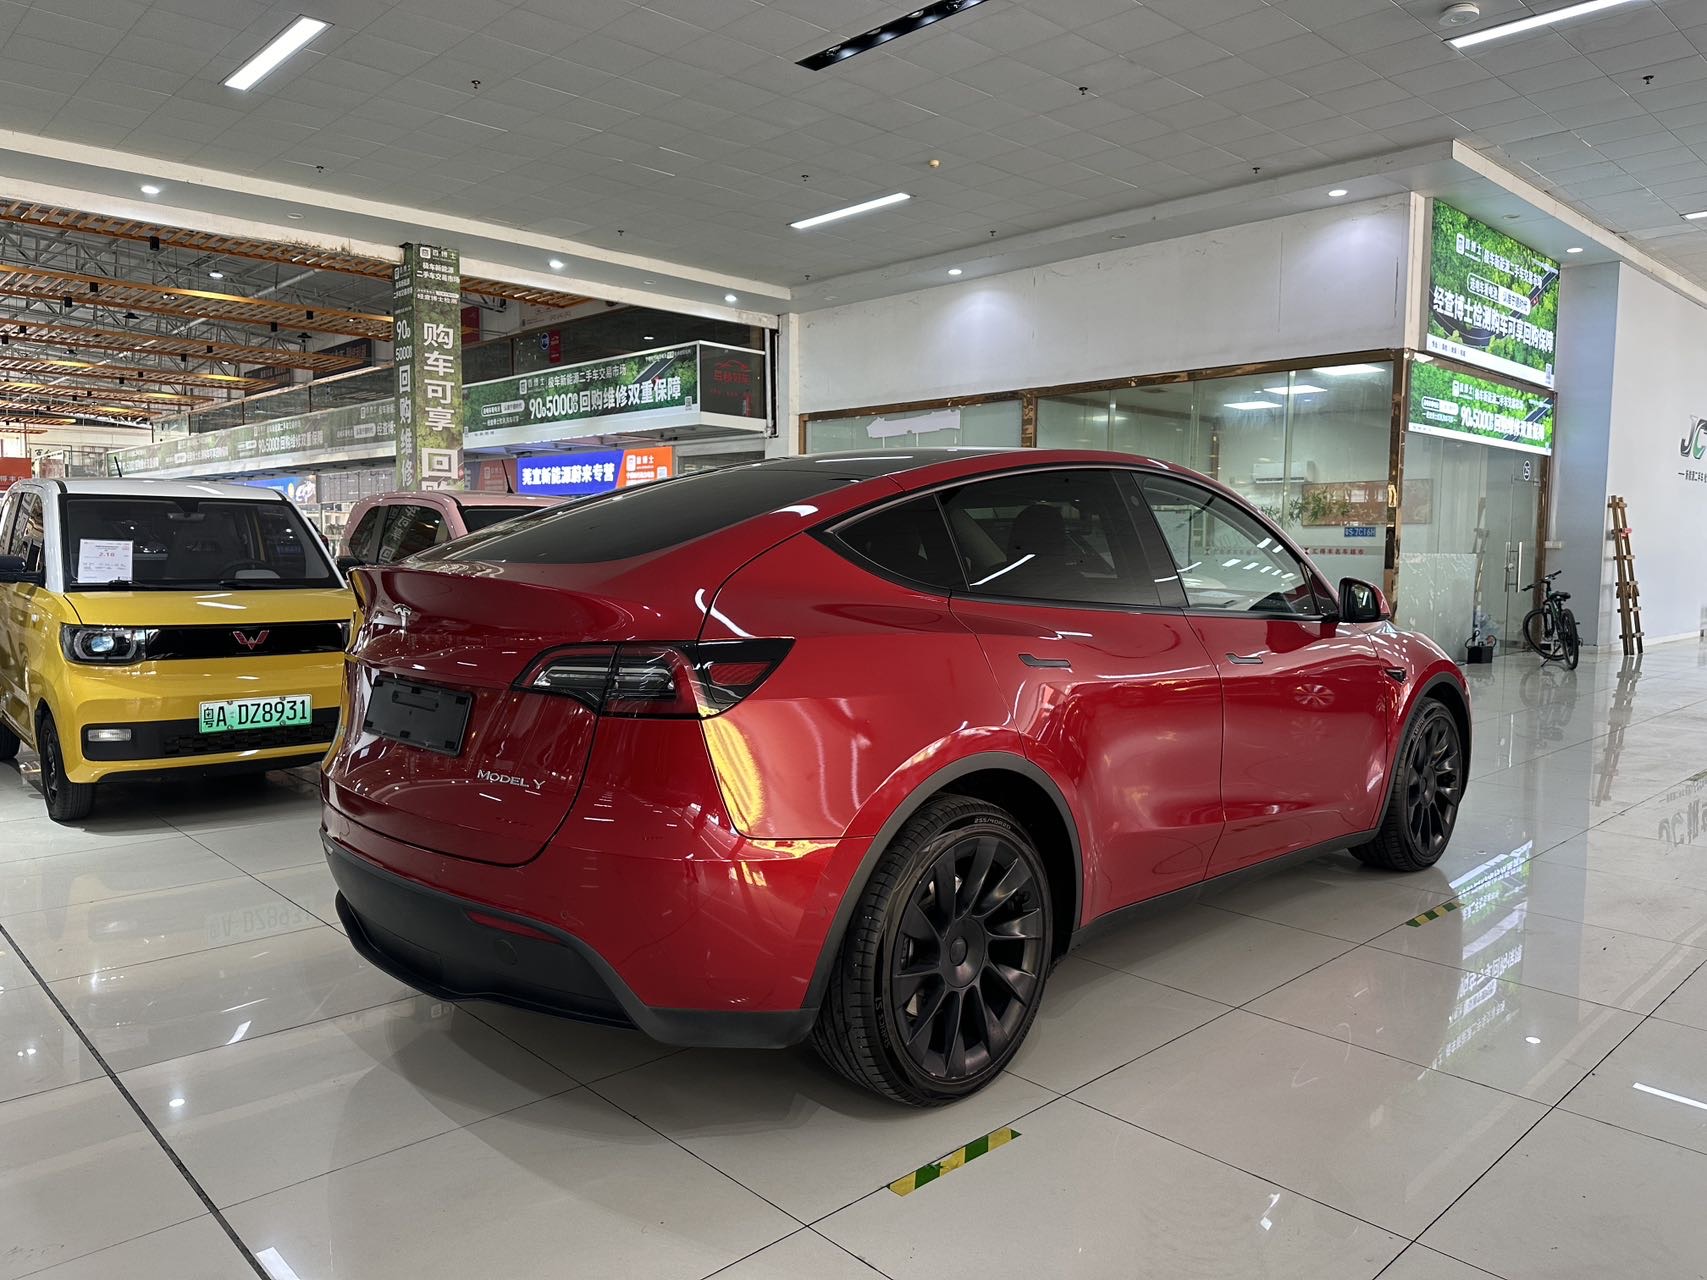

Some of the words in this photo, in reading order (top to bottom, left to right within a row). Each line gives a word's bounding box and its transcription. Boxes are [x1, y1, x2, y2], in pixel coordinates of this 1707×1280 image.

[1432, 285, 1554, 354] 经查博士检测购车可享回购保障
[422, 322, 455, 431] 购车可享
[477, 769, 530, 788] MODEL
[532, 779, 546, 790] Y
